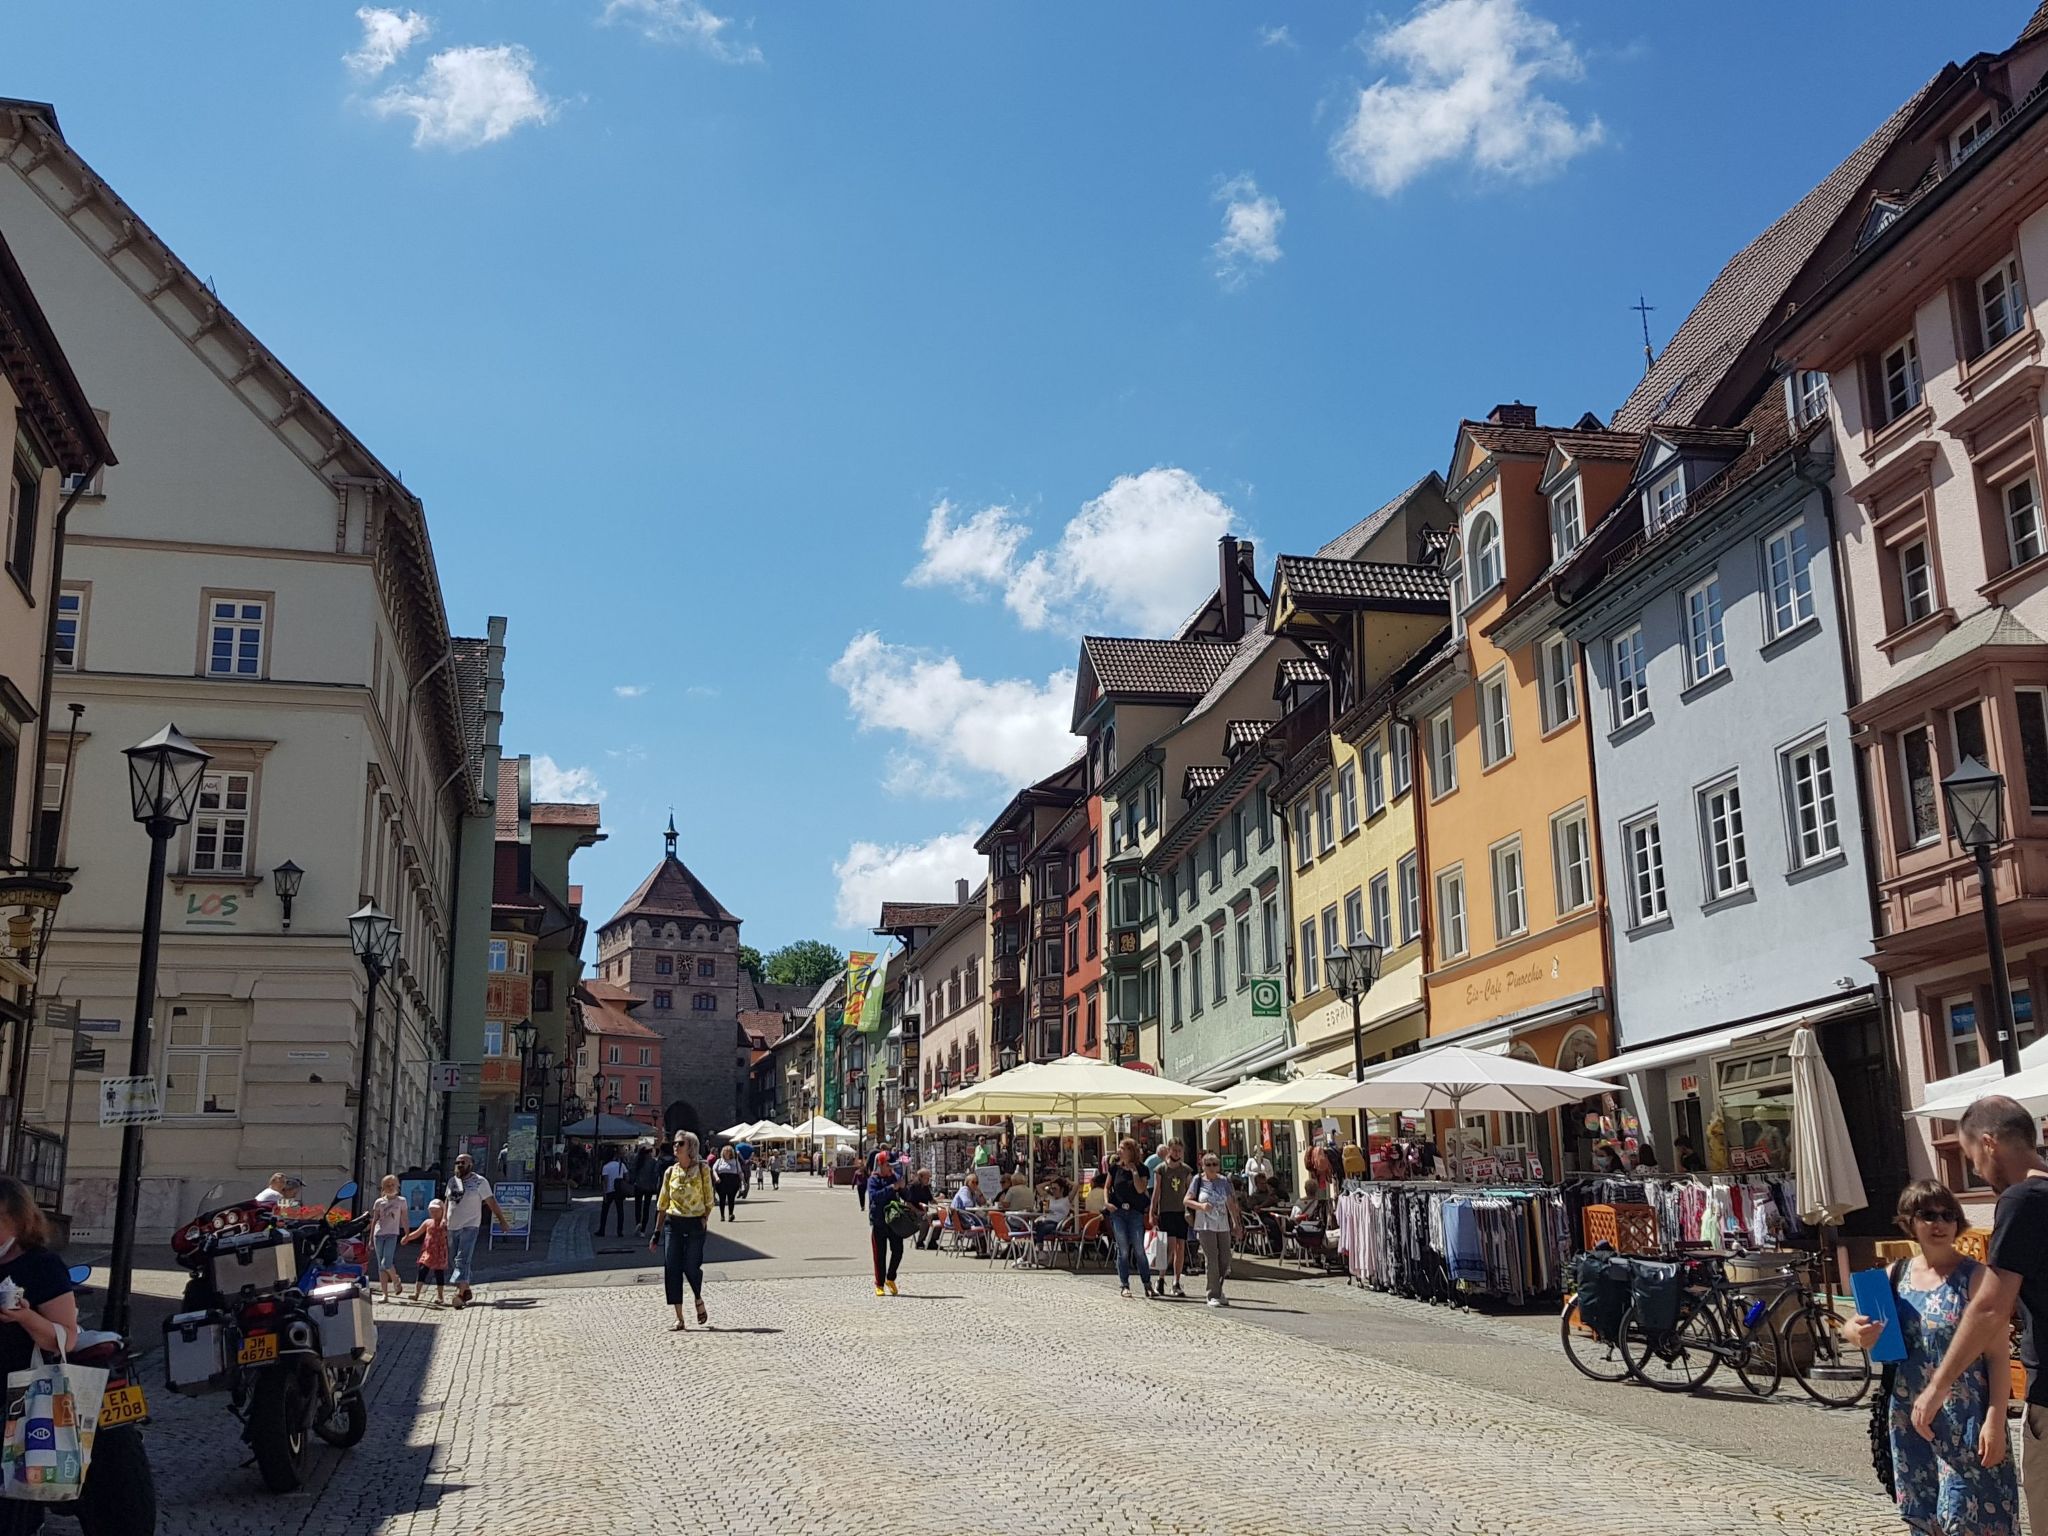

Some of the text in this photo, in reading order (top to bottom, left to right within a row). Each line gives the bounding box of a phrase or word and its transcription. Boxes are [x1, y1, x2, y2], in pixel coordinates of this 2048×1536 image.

[187, 893, 239, 916] LOS
[1506, 962, 1543, 992] Pinocchio
[109, 1391, 129, 1406] EA
[102, 1402, 142, 1423] 2708
